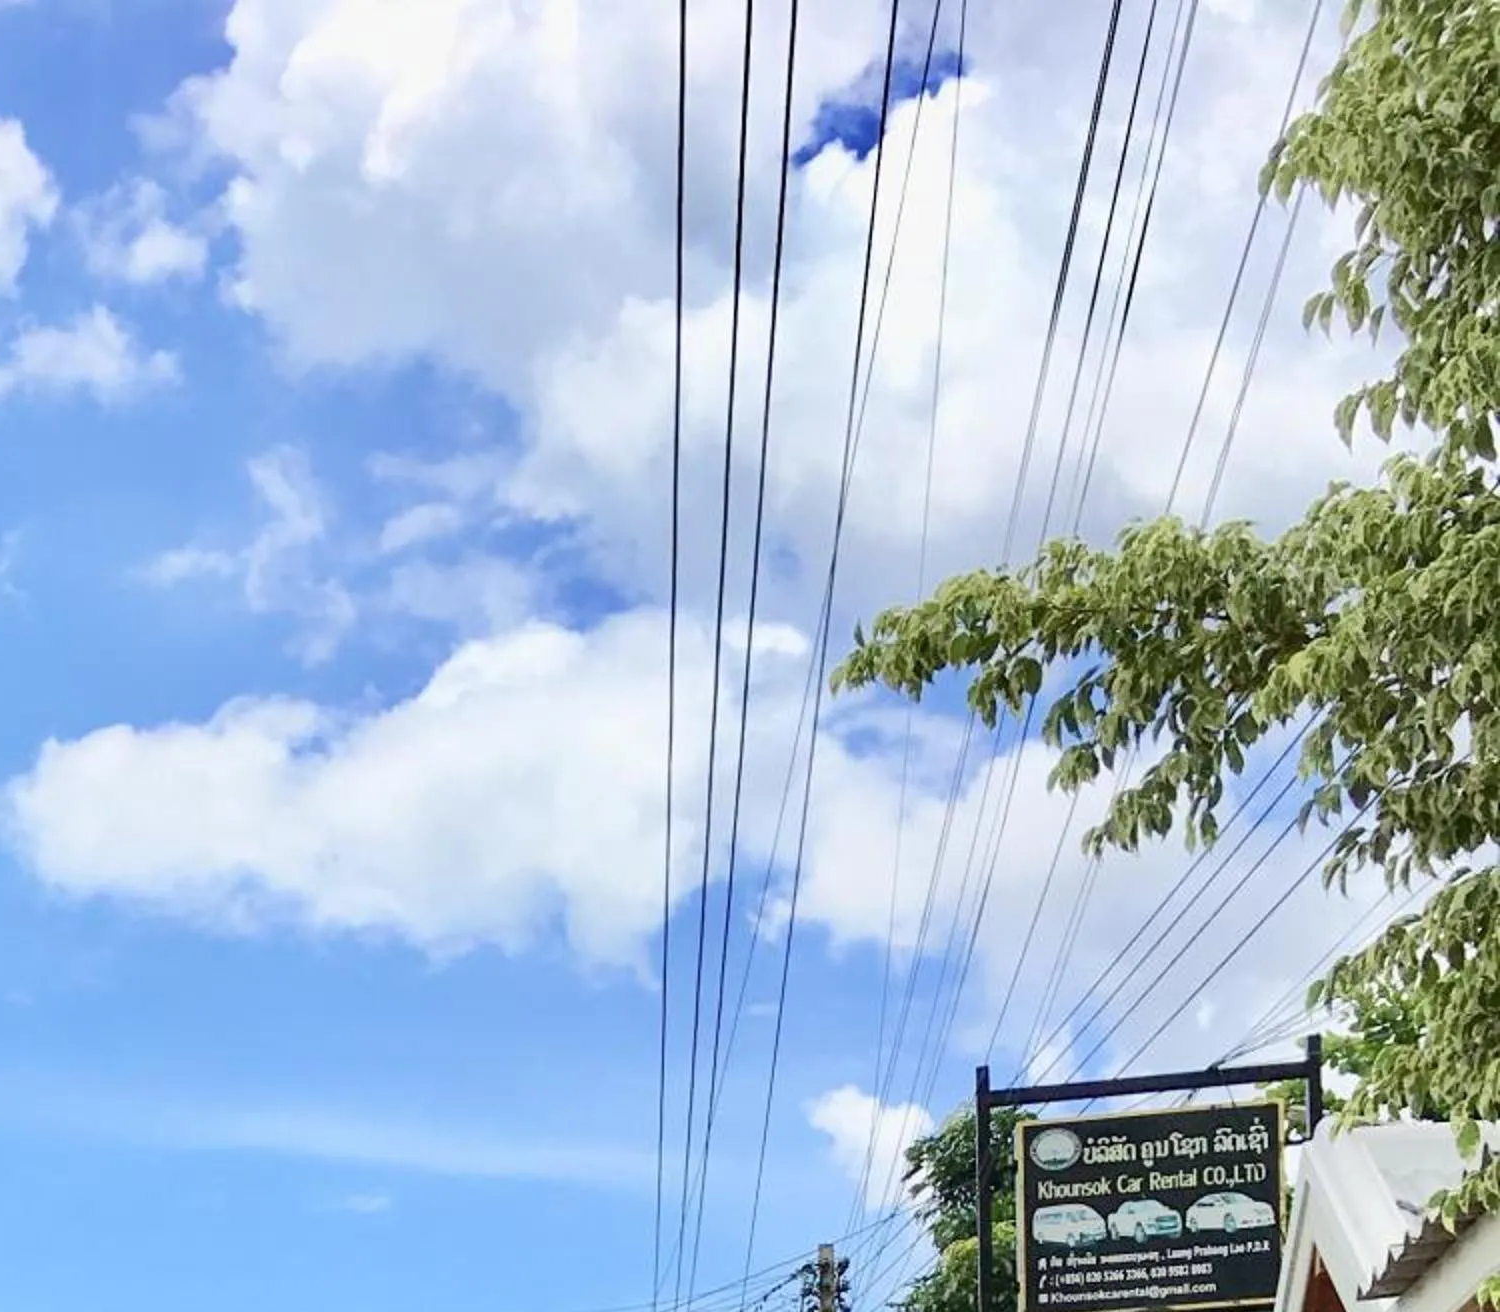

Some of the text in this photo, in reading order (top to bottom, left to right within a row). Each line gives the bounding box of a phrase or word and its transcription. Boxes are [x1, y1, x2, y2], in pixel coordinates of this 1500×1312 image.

[1037, 1176, 1112, 1200] Khounsok
[1117, 1174, 1143, 1194] Car
[1149, 1168, 1198, 1191] Rental
